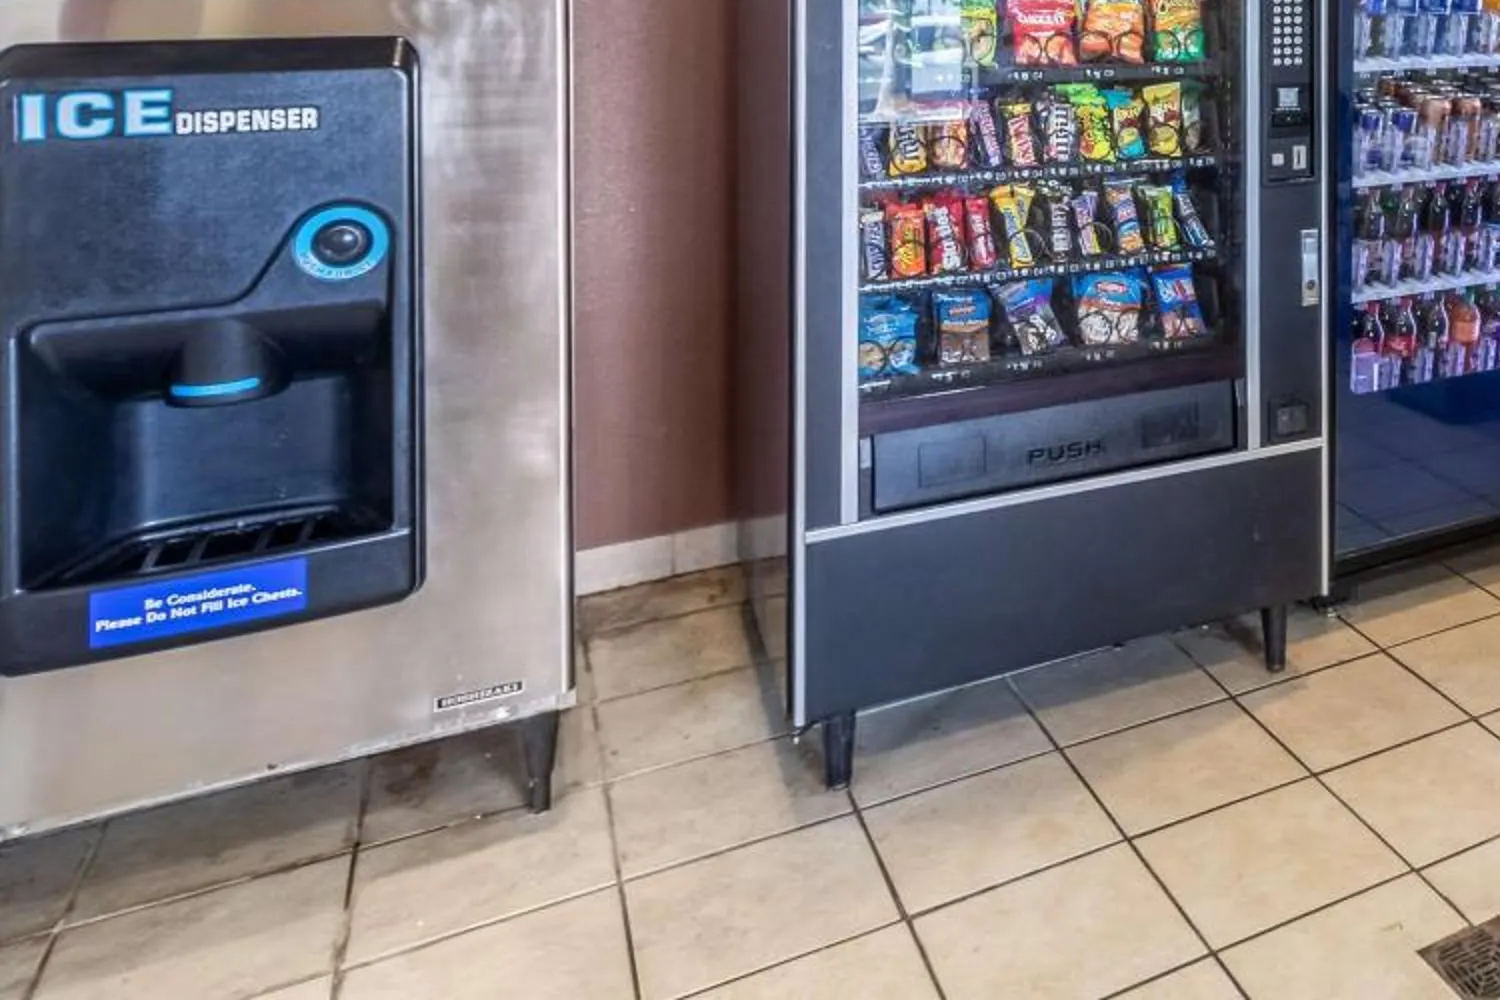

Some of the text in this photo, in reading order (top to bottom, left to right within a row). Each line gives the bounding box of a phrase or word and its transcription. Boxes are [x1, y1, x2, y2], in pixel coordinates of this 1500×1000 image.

[20, 87, 175, 141] ICE
[175, 106, 319, 136] DISPENSER
[1026, 440, 1107, 466] PUSH
[95, 587, 303, 633] Please Do Not Fill Ice Chests.
[144, 583, 256, 611] Be Considerate.
